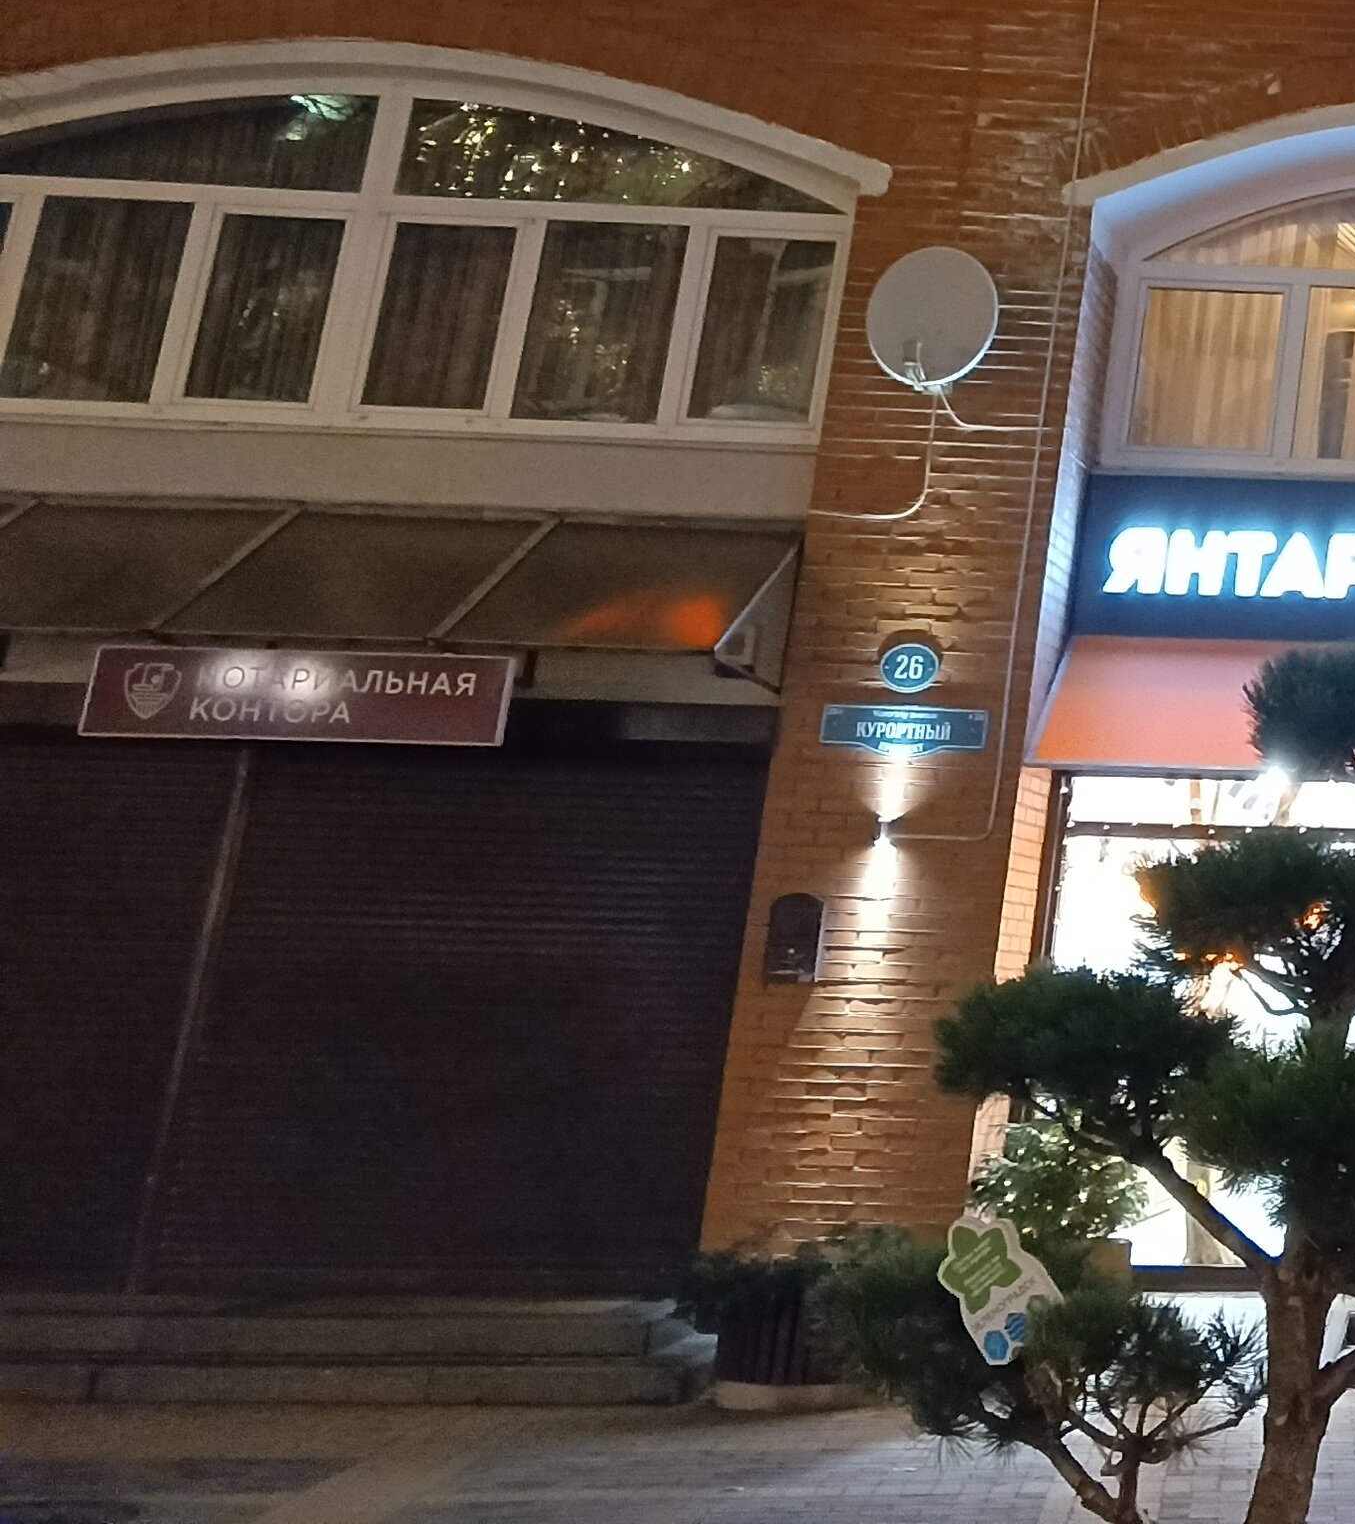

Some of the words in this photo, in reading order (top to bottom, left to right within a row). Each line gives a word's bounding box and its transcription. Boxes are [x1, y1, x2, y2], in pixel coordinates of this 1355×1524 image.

[893, 654, 924, 680] 26
[189, 696, 350, 725] КОНТОРА
[856, 721, 951, 741] КУРОРТНЫЙ
